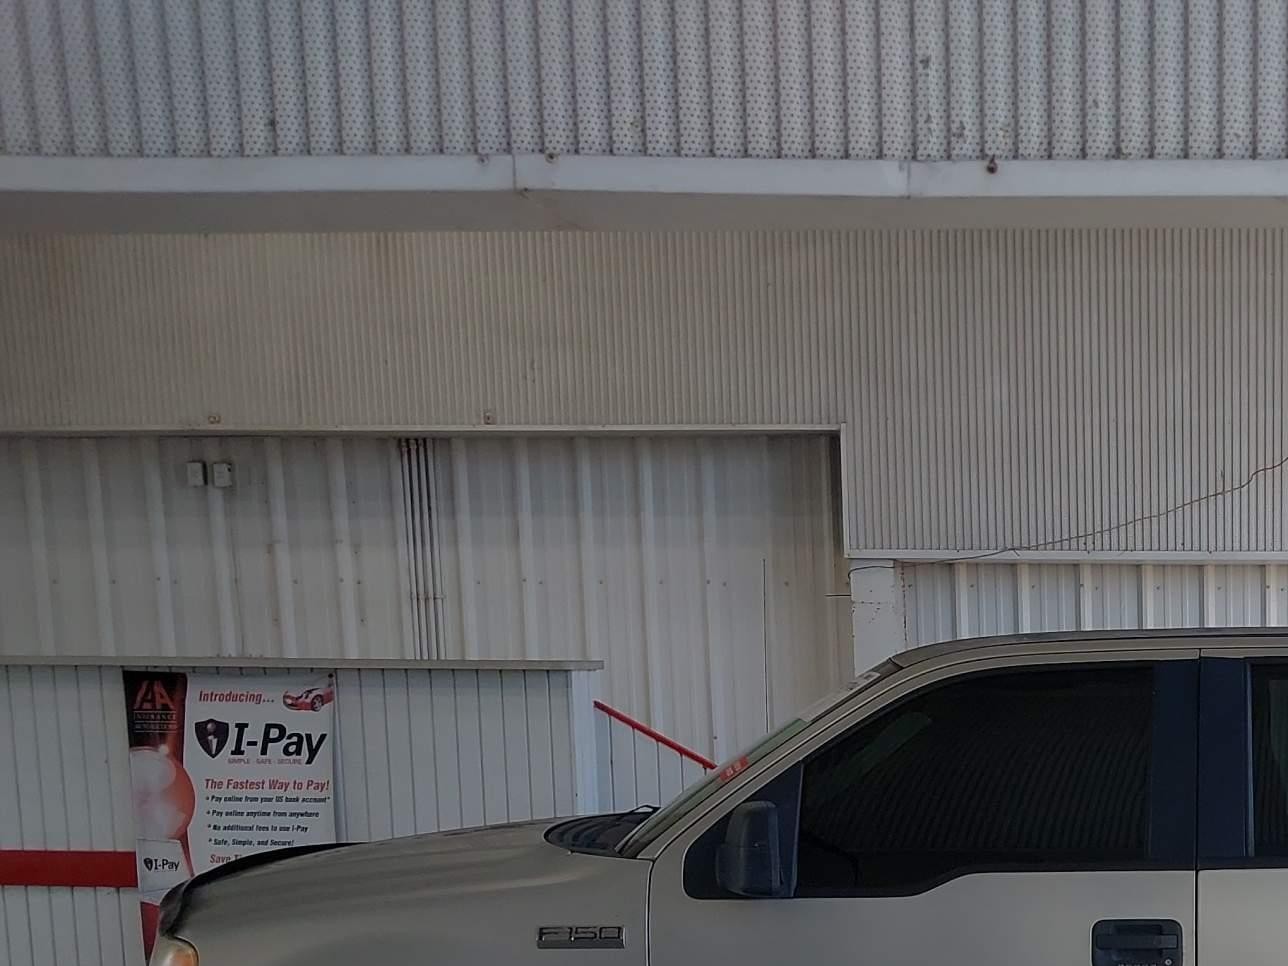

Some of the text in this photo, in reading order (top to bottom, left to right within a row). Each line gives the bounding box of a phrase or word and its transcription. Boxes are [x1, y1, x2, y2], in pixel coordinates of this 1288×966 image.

[198, 689, 275, 705] Introducing...
[230, 722, 328, 765] I-Pay
[205, 778, 330, 793] The Fastest Way to Pay!
[210, 795, 223, 804] Pay
[260, 796, 274, 804] your
[284, 795, 300, 803] bank
[211, 809, 320, 819] Pay online anytime from anywhere
[222, 824, 254, 832] additional
[255, 824, 270, 832] fees
[270, 824, 278, 832] to
[291, 824, 308, 833] I-Pay
[213, 838, 230, 847] Safe,
[231, 838, 255, 847] Simple,
[269, 839, 295, 847] Secure!
[209, 854, 231, 864] Save
[153, 858, 180, 872] I-Pay
